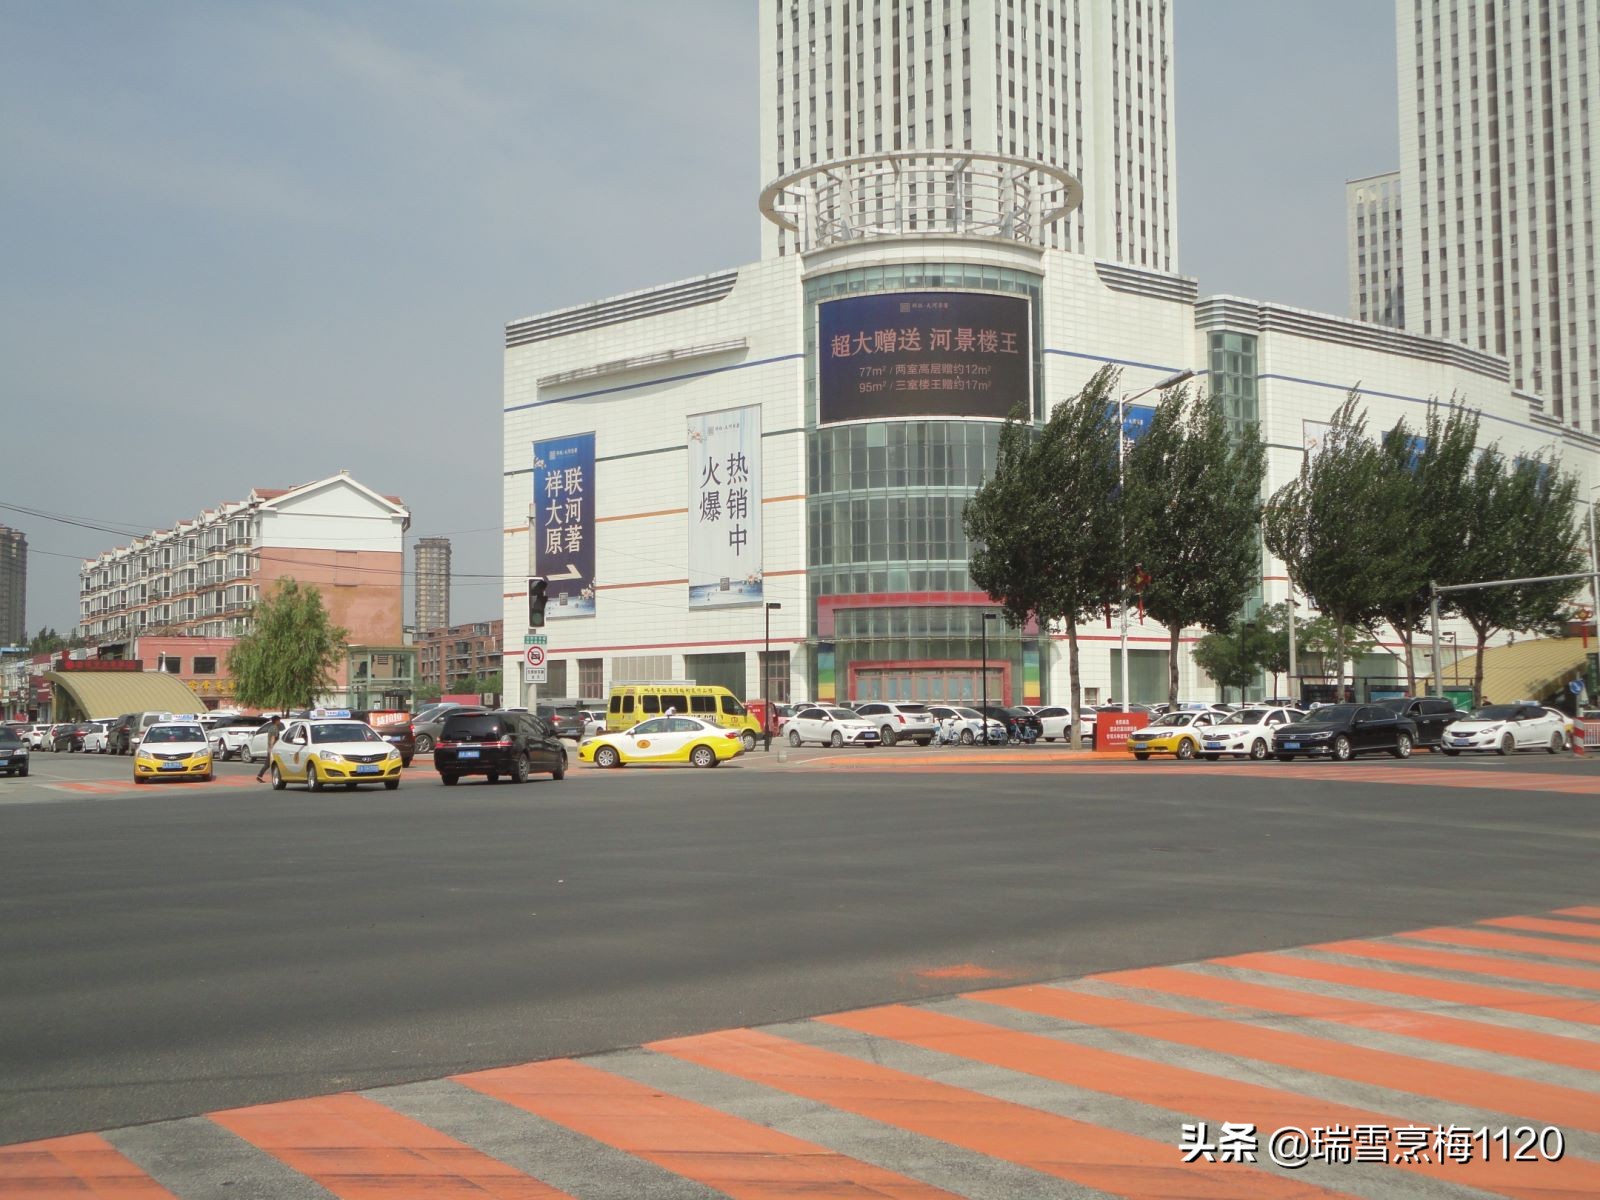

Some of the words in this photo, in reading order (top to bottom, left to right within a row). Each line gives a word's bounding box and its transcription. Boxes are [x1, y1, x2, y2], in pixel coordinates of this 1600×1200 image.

[830, 327, 921, 358] 超大赠送
[930, 327, 1018, 355] 河景楼王
[699, 456, 722, 523] 火爆
[726, 451, 749, 557] 热销中
